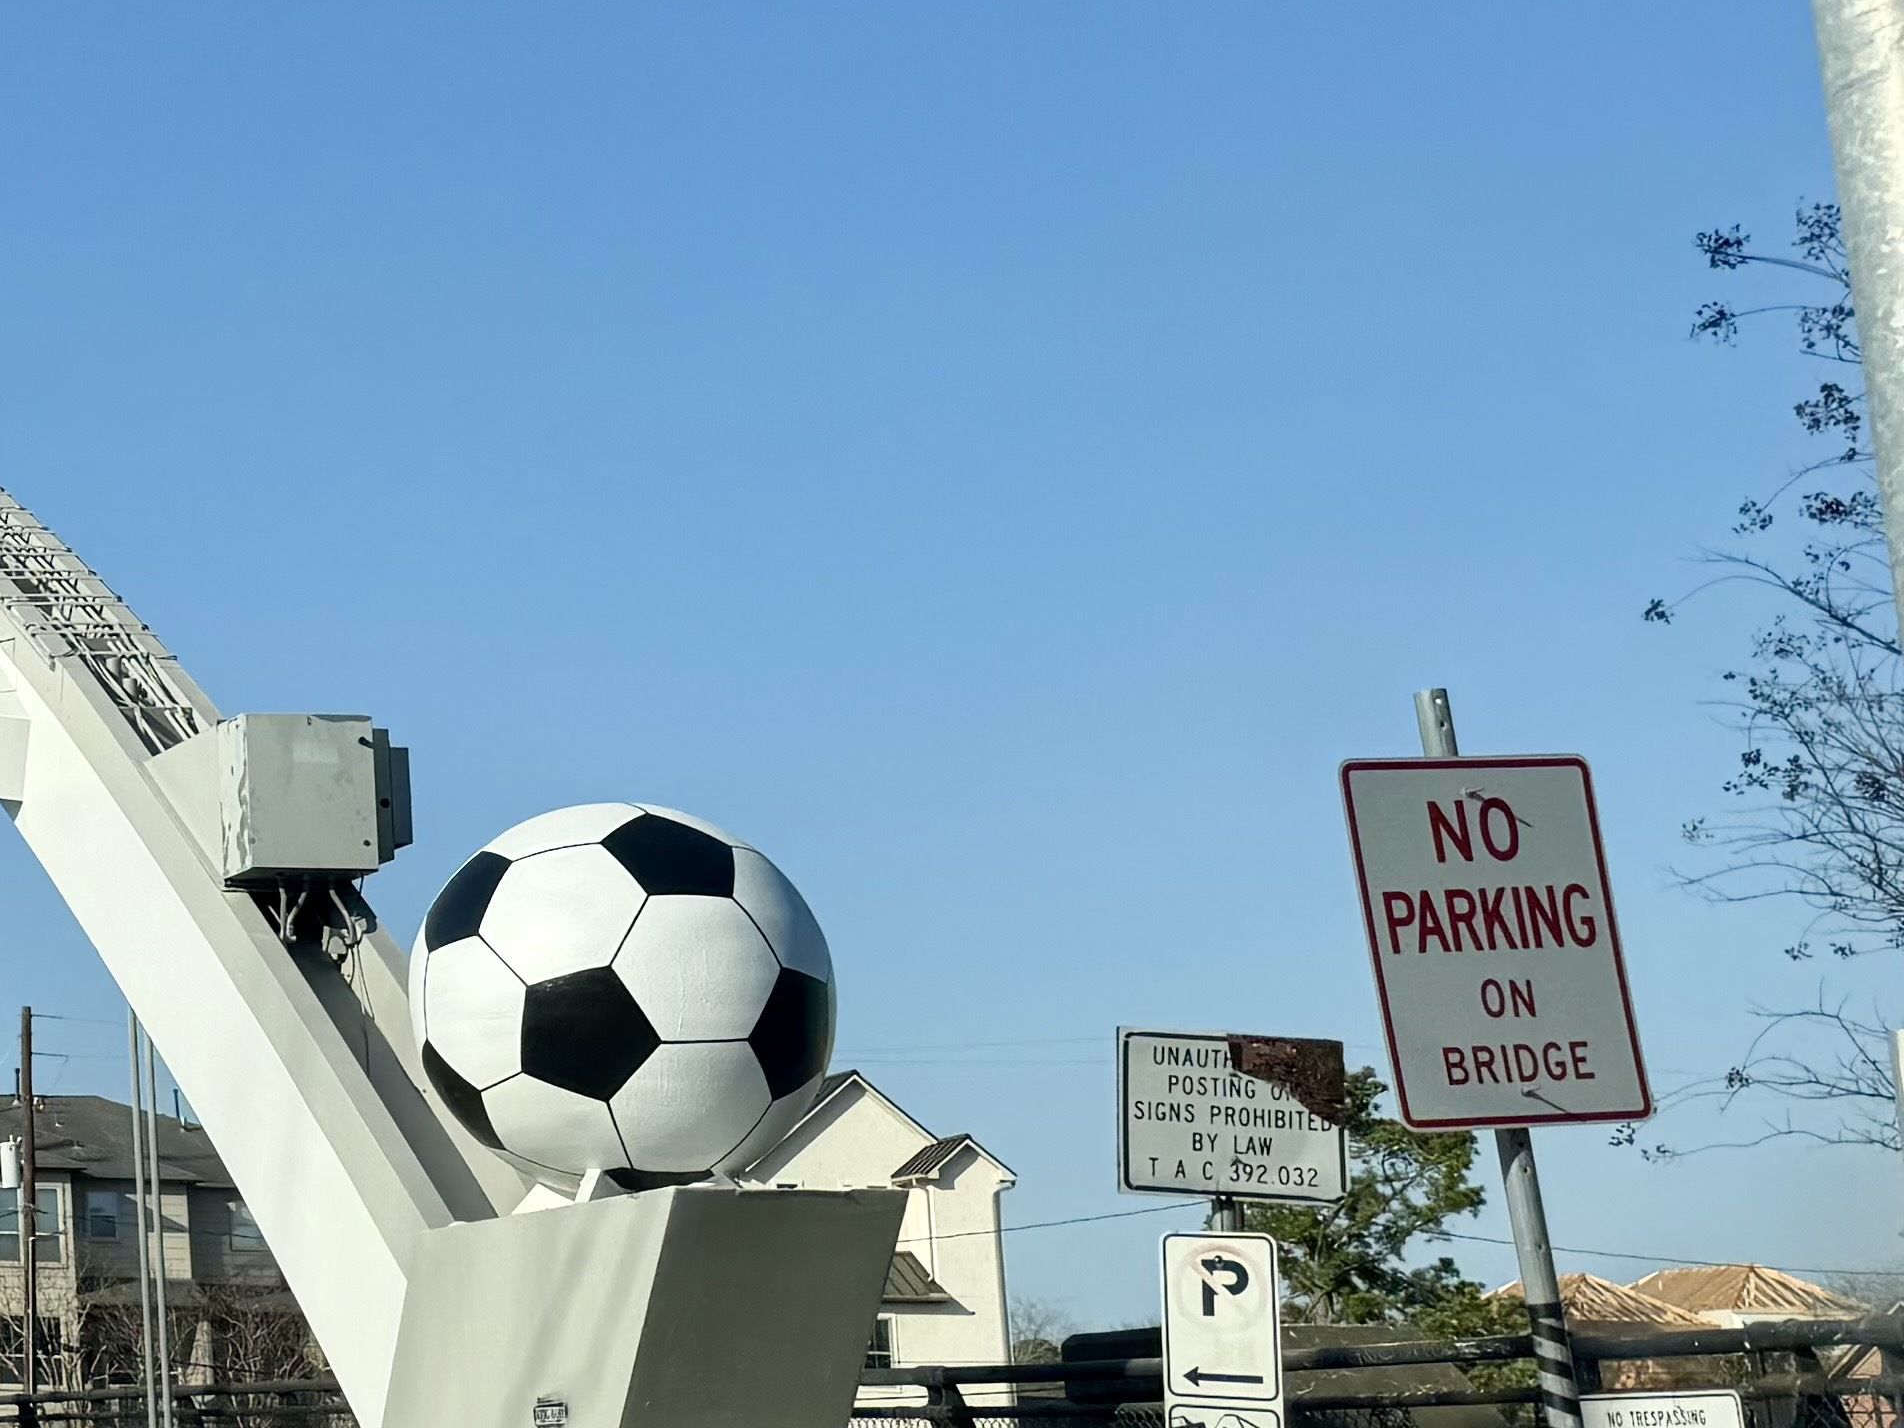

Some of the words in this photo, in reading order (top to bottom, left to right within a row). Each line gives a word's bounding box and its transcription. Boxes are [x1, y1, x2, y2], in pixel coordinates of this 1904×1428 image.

[1426, 797, 1519, 863] NO
[1382, 883, 1597, 954] PARKING
[1481, 978, 1537, 1019] ON
[1442, 1041, 1595, 1086] BRIDGE
[1168, 1075, 1256, 1099] POSTING
[1134, 1100, 1195, 1123] SIGNS
[1210, 1105, 1333, 1132] PROHIBITED
[1192, 1132, 1218, 1153] BY
[1234, 1135, 1273, 1156] LAW
[1149, 1157, 1159, 1179] T
[1175, 1159, 1186, 1179] A
[1203, 1161, 1213, 1181] C
[1229, 1162, 1319, 1188] 392.032
[1607, 1411, 1624, 1428] NO
[1630, 1409, 1707, 1428] TRESPASSING
